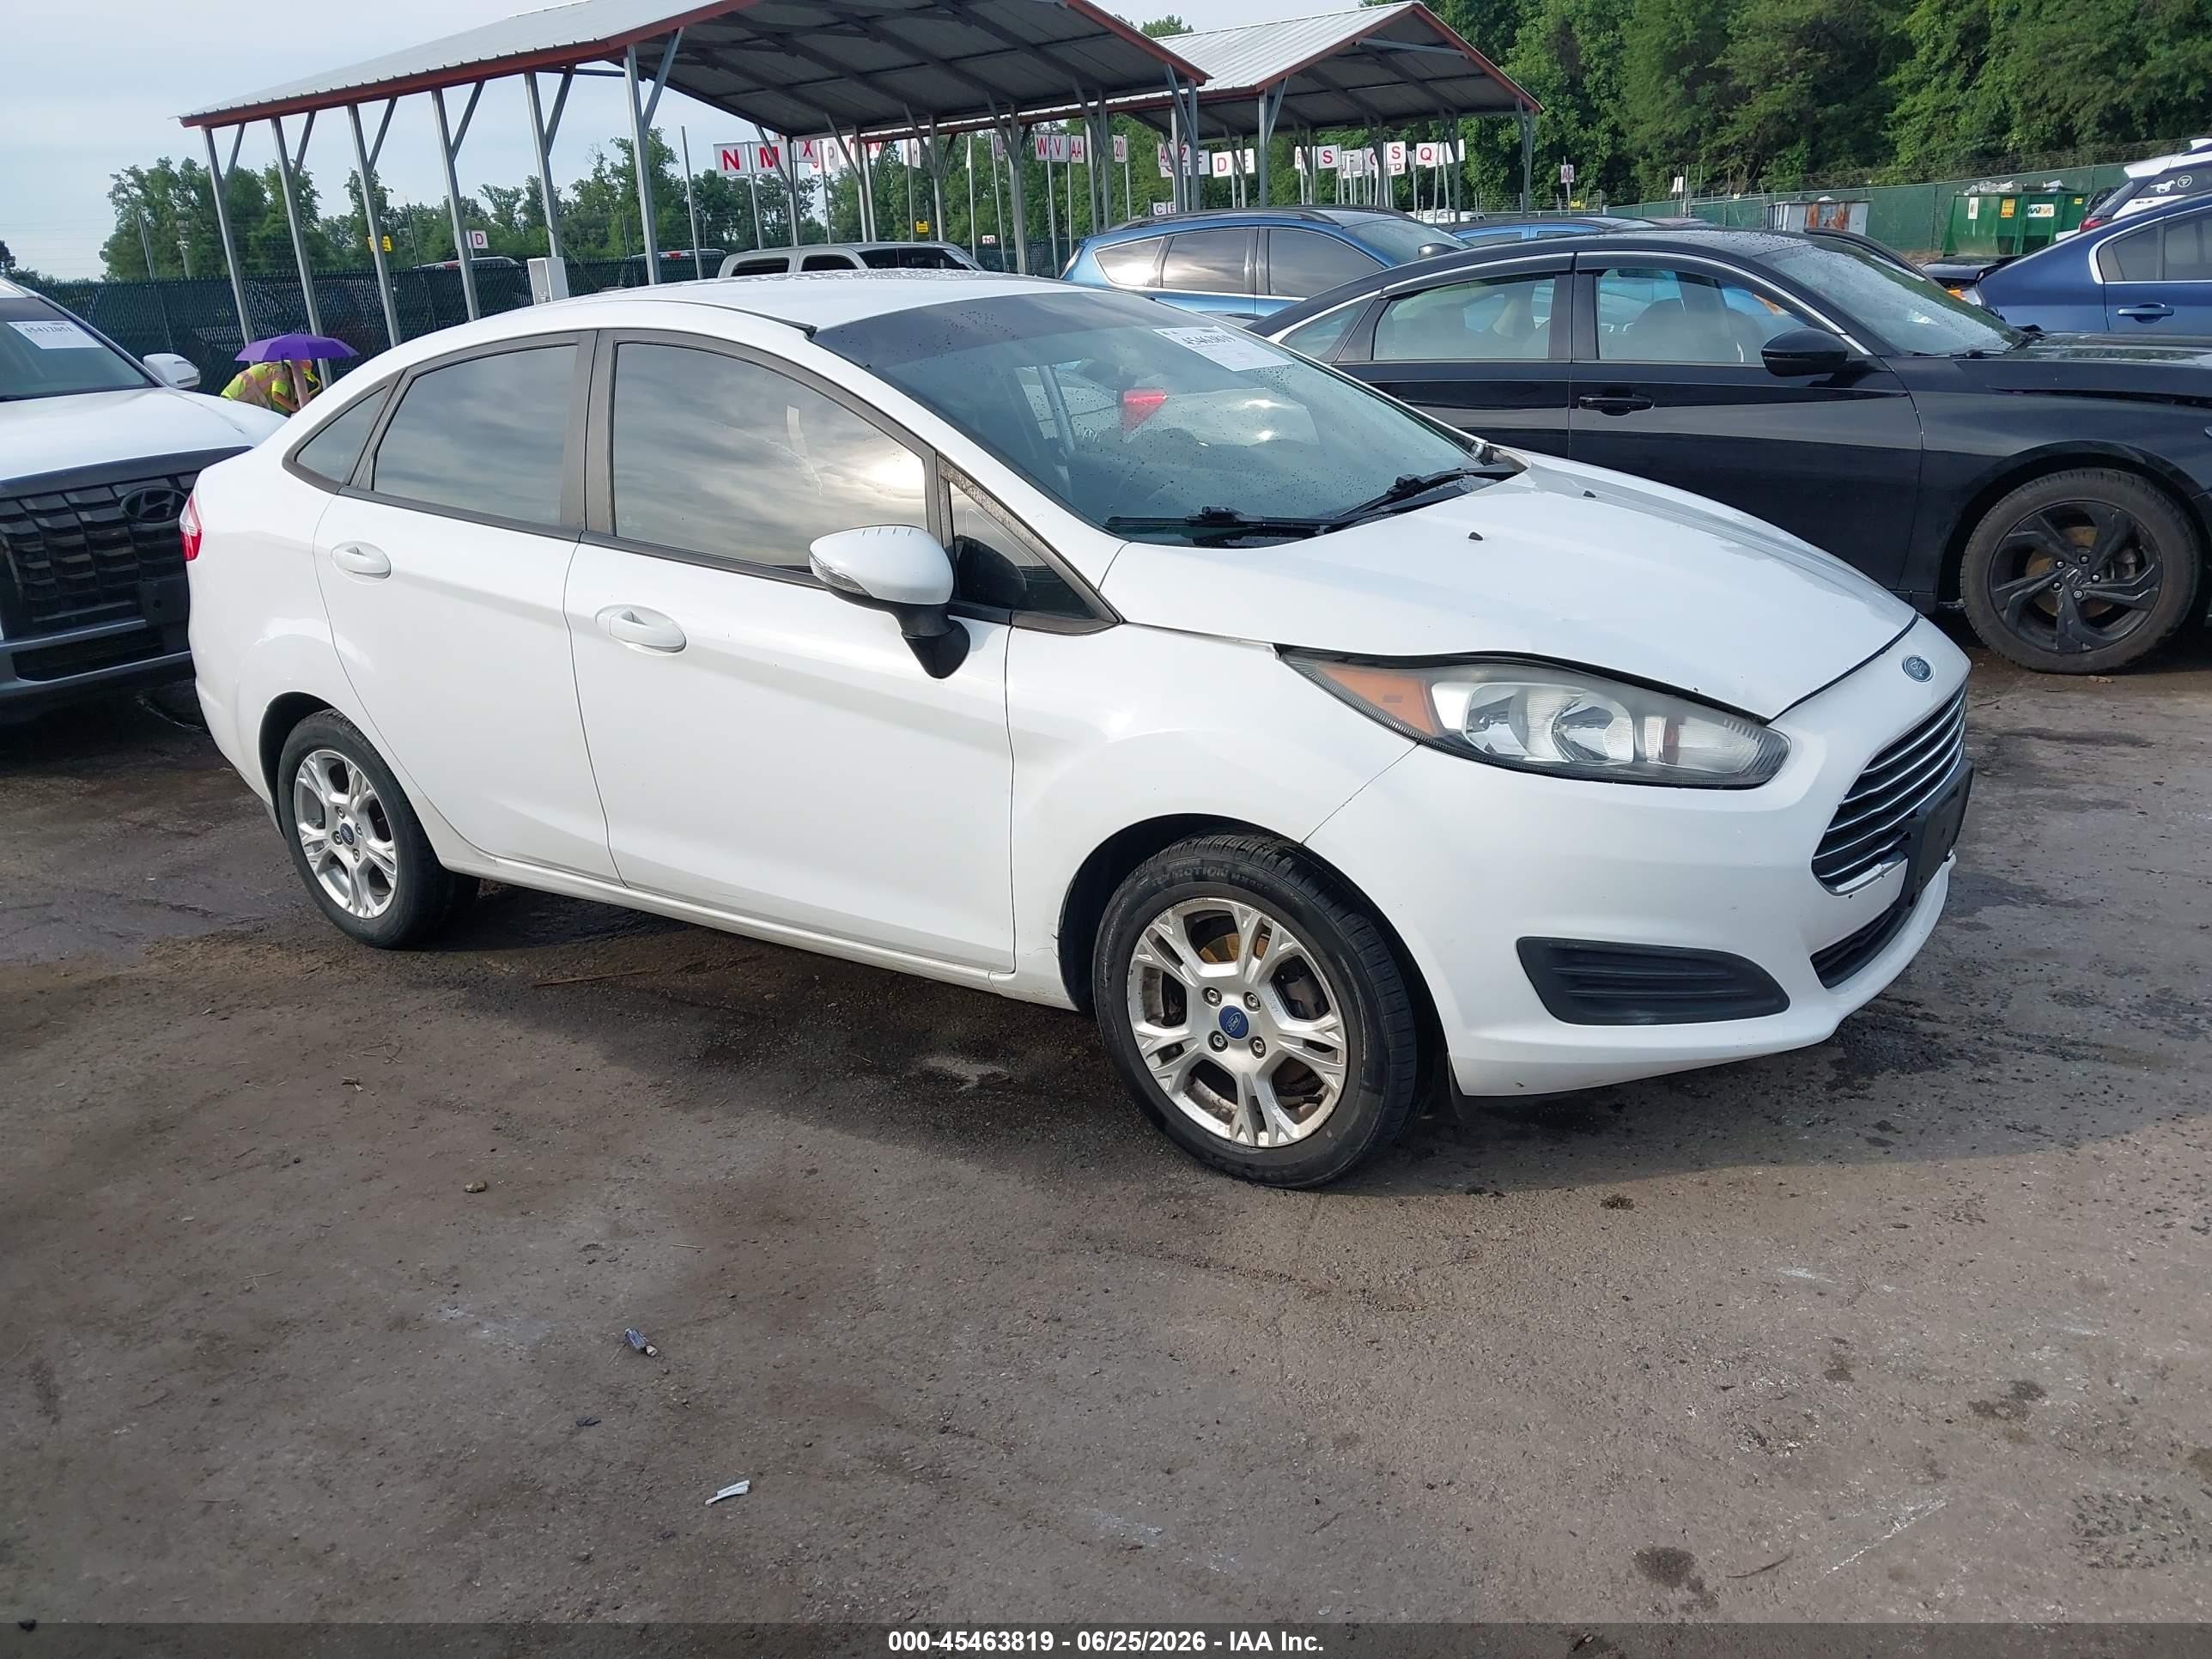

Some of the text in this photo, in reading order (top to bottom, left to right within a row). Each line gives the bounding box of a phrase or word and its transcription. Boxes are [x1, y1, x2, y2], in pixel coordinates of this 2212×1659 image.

[803, 139, 813, 158] X
[1036, 137, 1047, 155] W
[1054, 139, 1061, 156] V
[1072, 141, 1082, 157] AA
[1115, 140, 1124, 158] 20
[1391, 146, 1401, 160] S
[1420, 147, 1432, 161] Q
[721, 149, 740, 170] N
[759, 146, 780, 168] M
[1322, 149, 1333, 164] S
[1217, 157, 1226, 173] D
[1156, 204, 1163, 214] C
[475, 233, 483, 246] D
